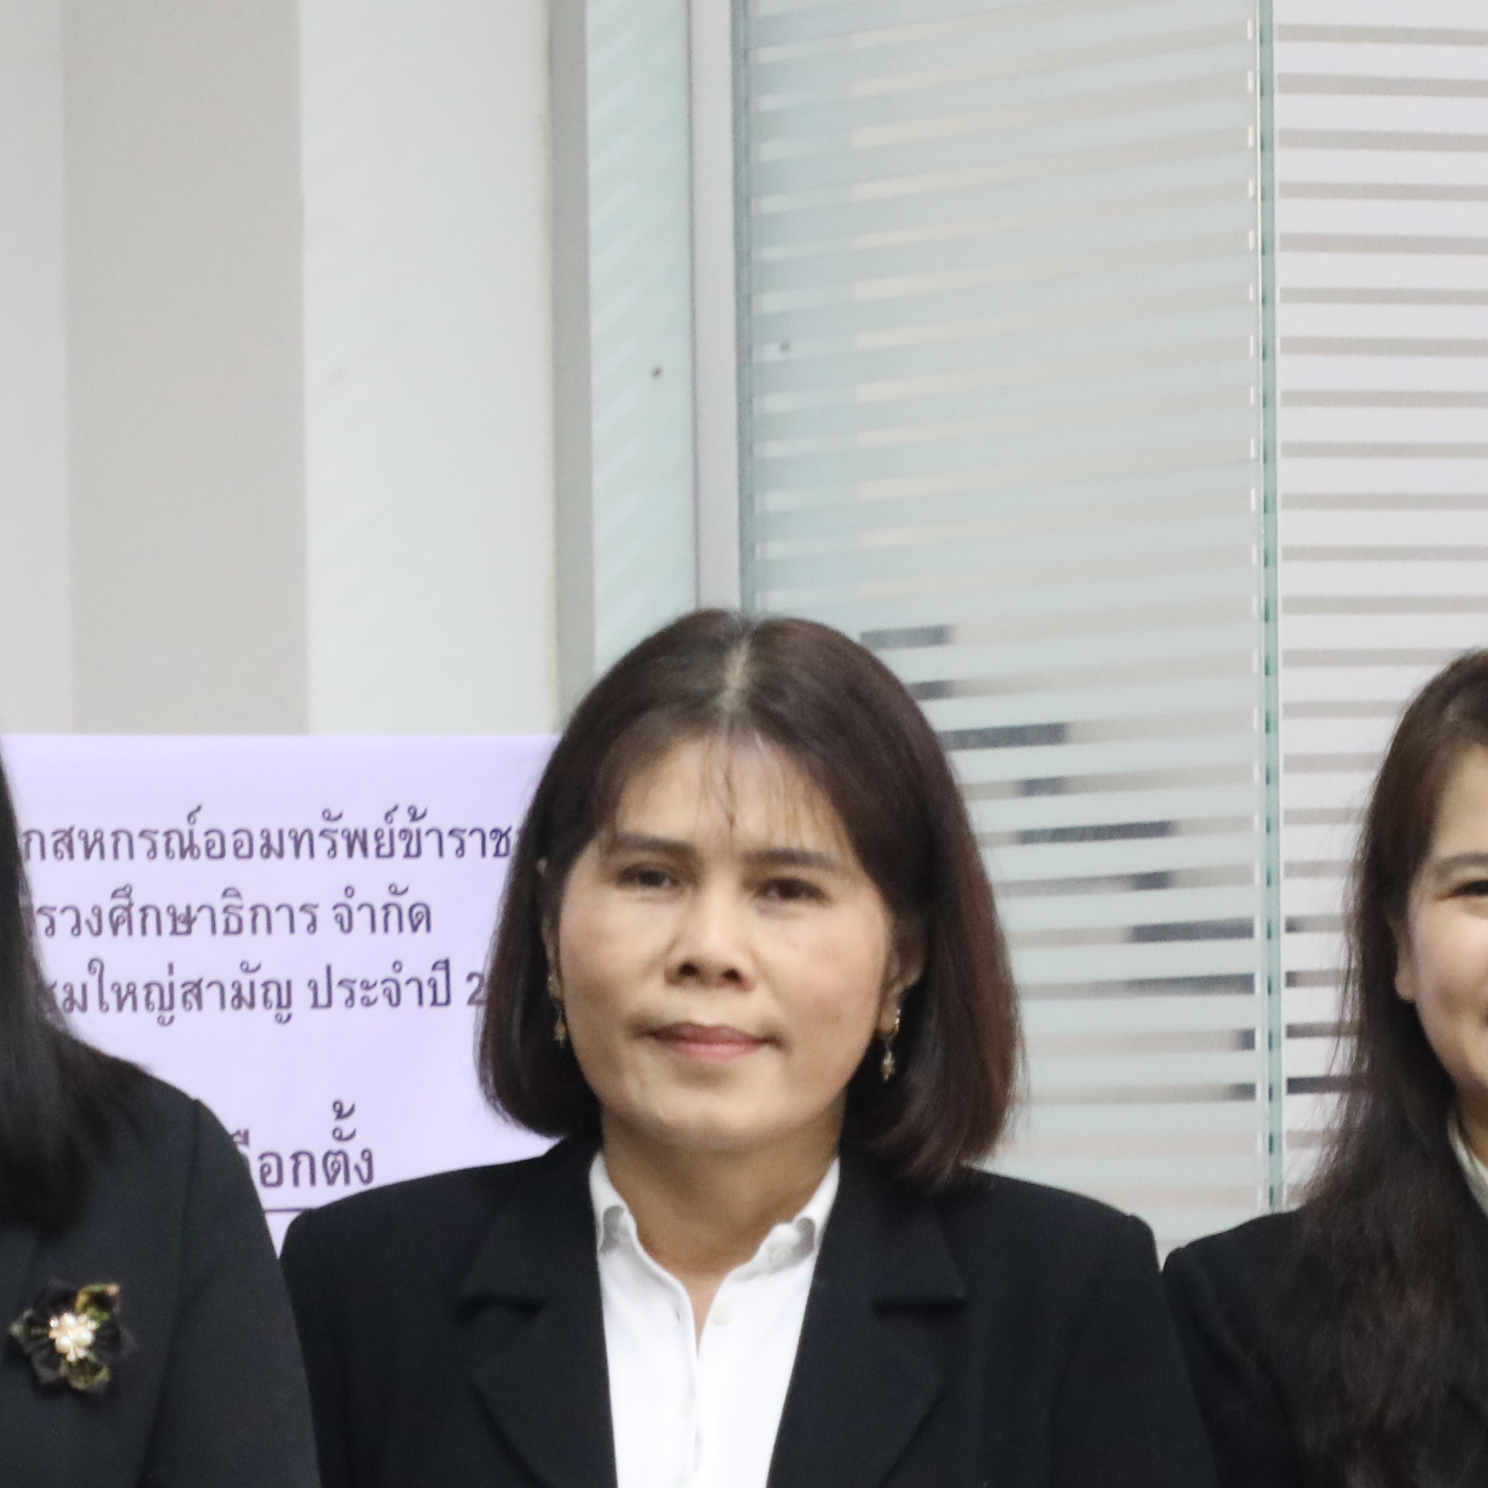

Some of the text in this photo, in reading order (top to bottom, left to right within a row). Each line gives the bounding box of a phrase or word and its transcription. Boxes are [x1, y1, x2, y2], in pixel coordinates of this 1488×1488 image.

[333, 882, 433, 935] จำกัด
[48, 957, 294, 1027] มใหญ่สามัญ
[309, 957, 452, 1011] ประจำปี
